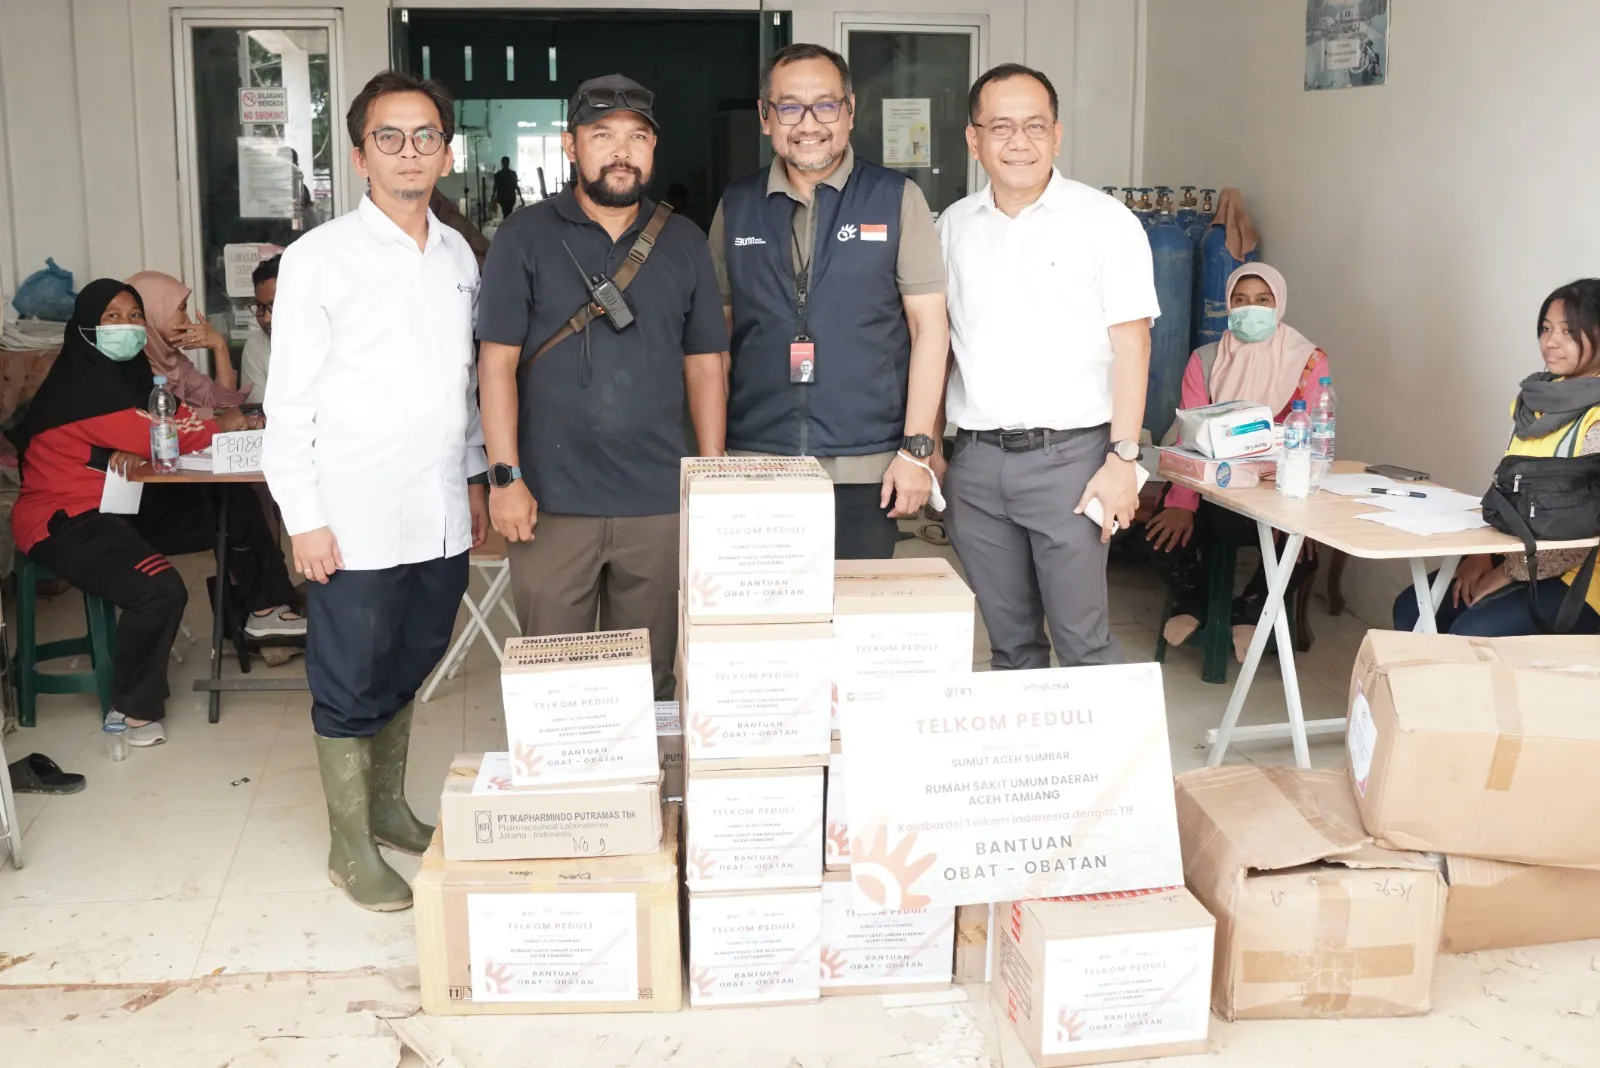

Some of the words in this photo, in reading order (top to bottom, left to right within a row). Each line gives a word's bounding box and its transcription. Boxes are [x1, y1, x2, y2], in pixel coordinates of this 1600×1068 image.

[243, 111, 253, 120] NO
[255, 111, 285, 120] SMOKING
[740, 579, 788, 587] BANTUAN
[522, 636, 581, 645] DIBANTING
[586, 632, 632, 640] JANGAN
[518, 657, 565, 665] HANDLE
[569, 654, 599, 662] WITH
[602, 651, 633, 659] CARE
[737, 721, 783, 729] BANTUAN
[915, 713, 1007, 735] TELKOM
[1017, 708, 1094, 730] PEDULI
[561, 747, 608, 757] BANTUAN
[951, 756, 991, 768] SUMUT
[992, 754, 1023, 766] ACEH
[1024, 750, 1071, 763] SUMBAR
[925, 782, 971, 795] RUMAH
[973, 779, 1007, 791] SAKIT
[1010, 776, 1049, 789] UMUM
[1051, 772, 1099, 785] DAERAH
[968, 793, 1001, 806] ACEH
[1003, 789, 1061, 803] TAMIANG
[498, 814, 507, 823] PT
[510, 812, 573, 822] IKAPHARMINDO
[574, 811, 620, 820] PUTRAMAS
[622, 810, 636, 819] Tbk
[897, 817, 963, 833] Kolaborasi
[965, 815, 1010, 828] Telkom
[1072, 807, 1117, 823] dengan
[1119, 804, 1136, 816] TIF
[498, 823, 558, 832] Pharmaceutical
[498, 831, 527, 839] Jakarta
[533, 829, 572, 838] Indonesia
[975, 834, 1073, 855] BANTUAN
[943, 863, 998, 881] OBAT
[1024, 854, 1108, 875] OBATAN
[734, 970, 780, 979] BANTUAN
[1103, 1012, 1148, 1021] BANTUAN
